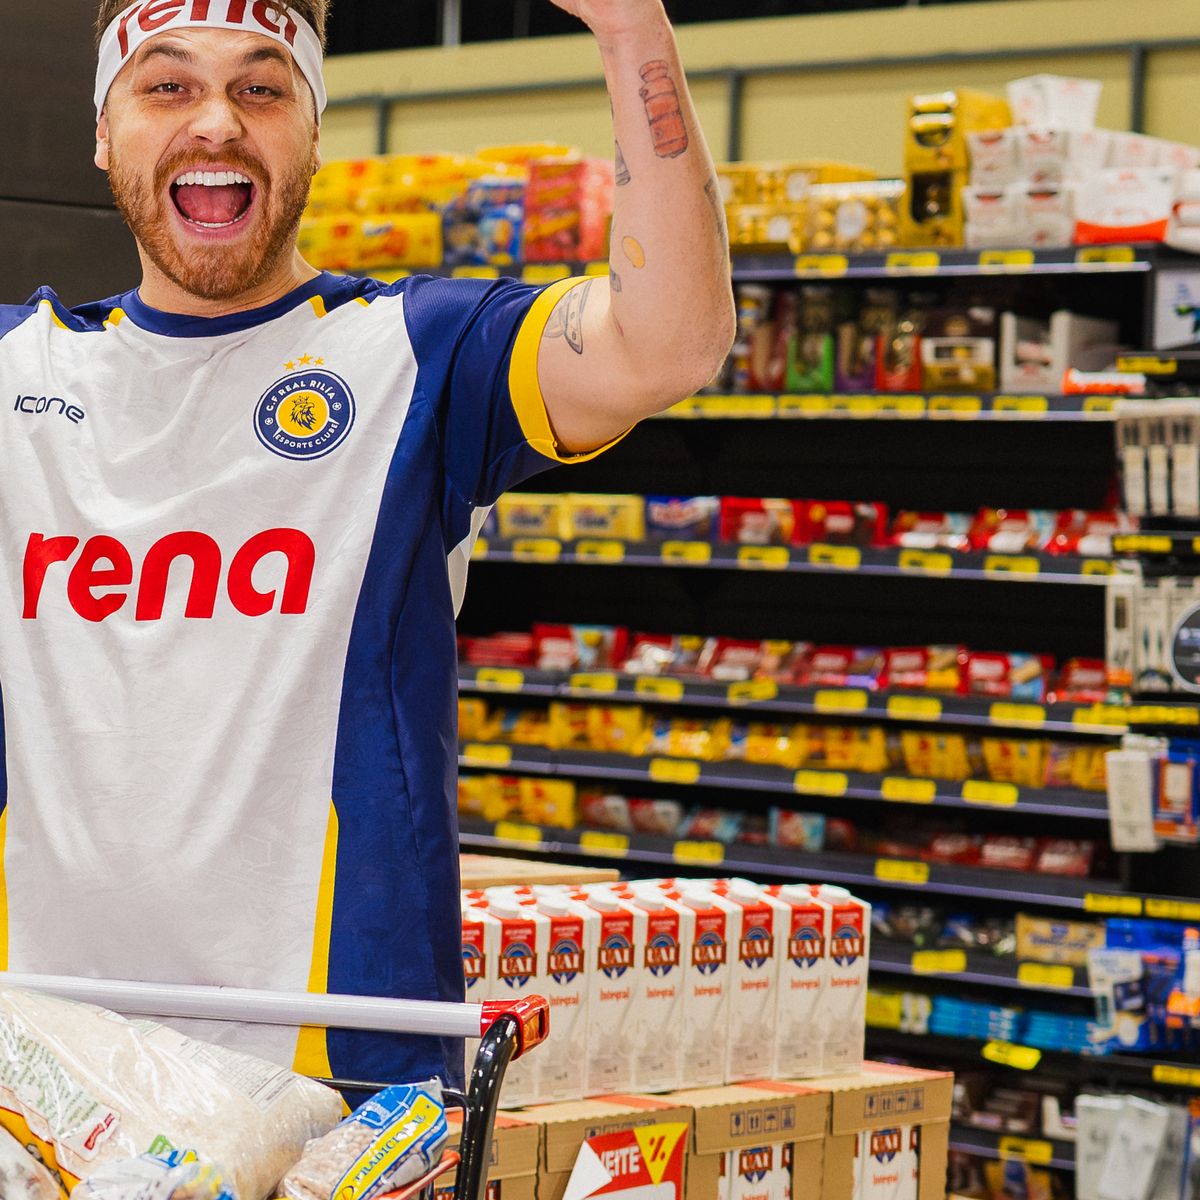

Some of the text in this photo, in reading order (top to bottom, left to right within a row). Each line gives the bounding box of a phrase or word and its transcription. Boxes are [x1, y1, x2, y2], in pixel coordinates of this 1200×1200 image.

[278, 381, 306, 396] REAL
[275, 423, 338, 448] ESPORTE CLUBE
[22, 528, 316, 622] rena
[550, 953, 579, 971] UAI
[601, 948, 630, 966] UAI
[647, 946, 675, 964] UAI
[502, 957, 533, 975] UAI
